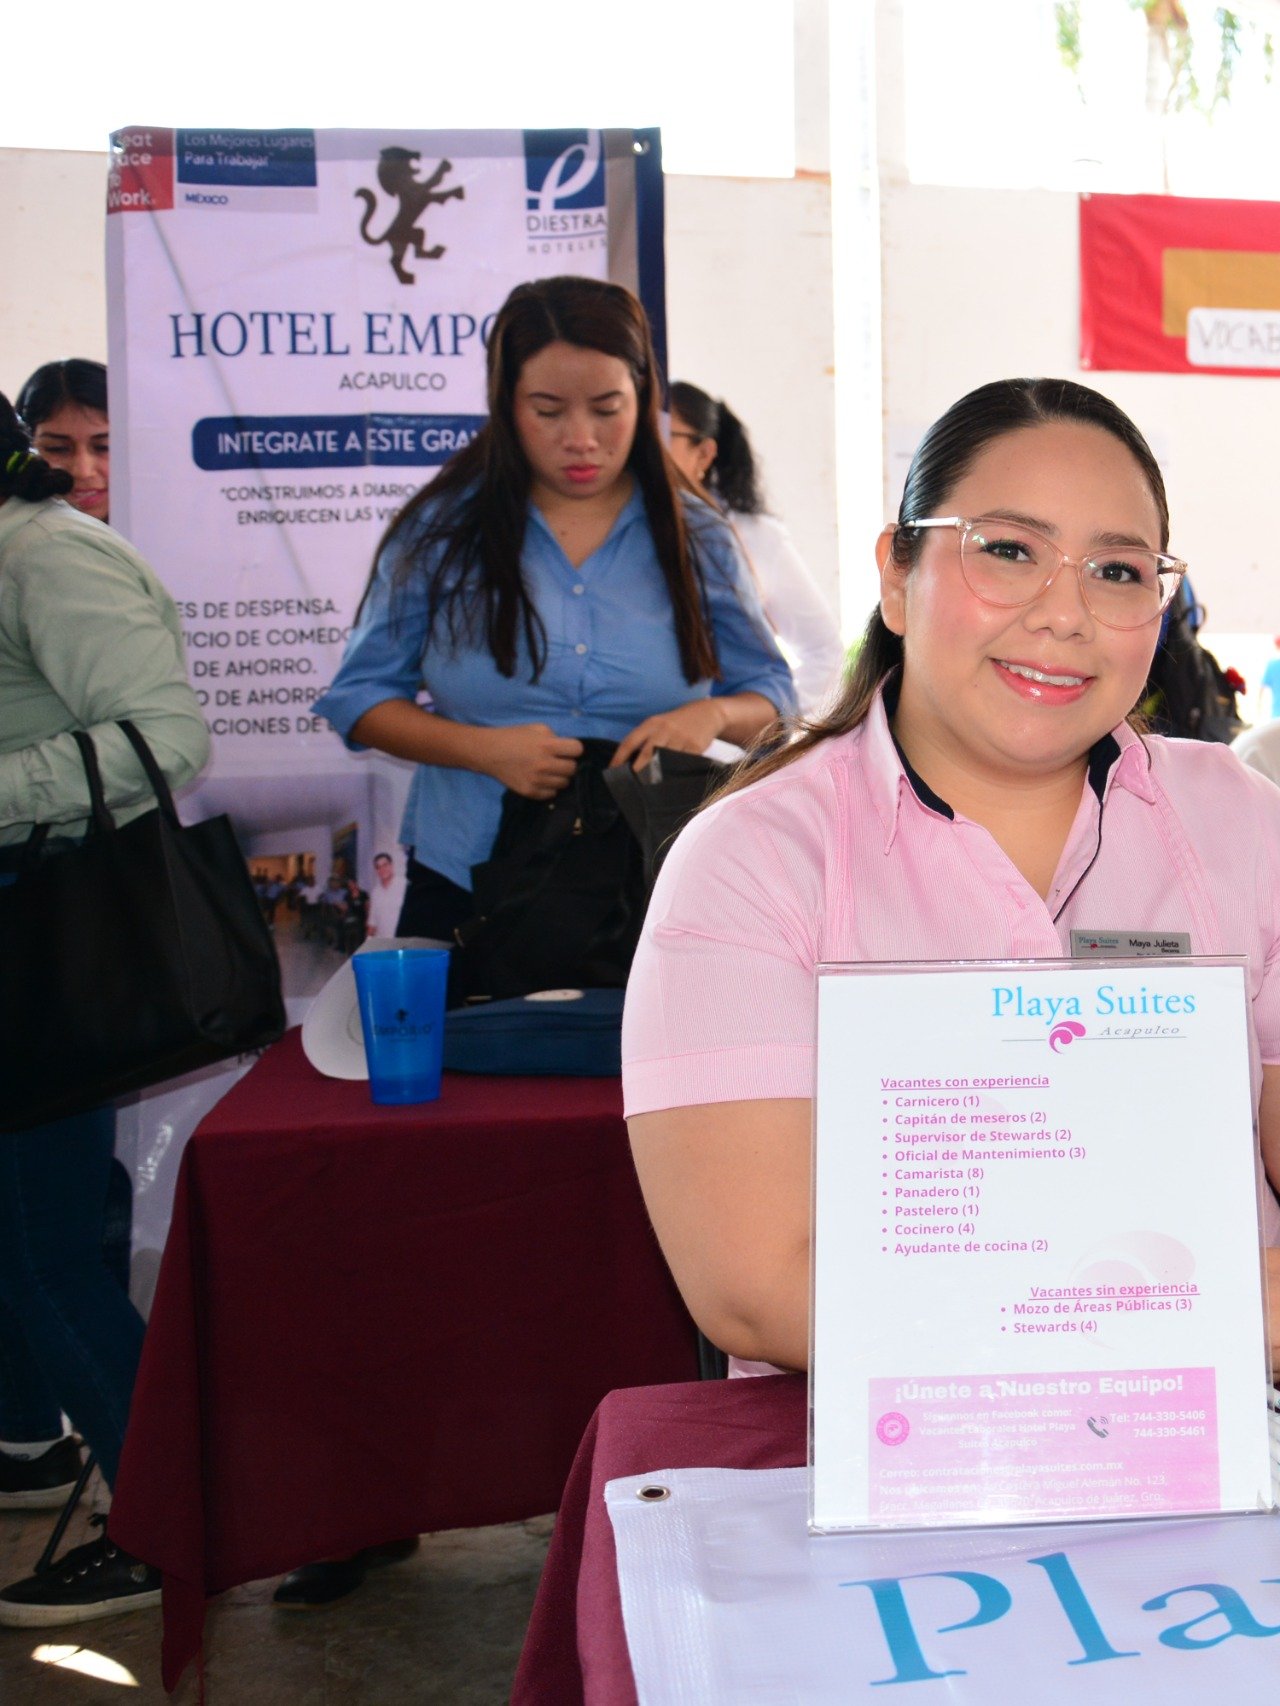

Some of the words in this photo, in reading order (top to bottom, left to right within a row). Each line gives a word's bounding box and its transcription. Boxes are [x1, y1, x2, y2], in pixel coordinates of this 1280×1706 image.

[185, 134, 205, 147] Los
[210, 134, 261, 150] Mejores
[264, 134, 314, 150] Lugares
[185, 152, 214, 166] Para
[526, 213, 607, 233] DIESTRA
[526, 238, 607, 255] HOTELES
[170, 311, 350, 358] HOTEL
[339, 372, 446, 392] ACAPULCO
[218, 430, 338, 456] INTEGRATE
[344, 430, 362, 452] A
[366, 428, 416, 452] ESTE
[350, 484, 359, 498] A
[237, 507, 340, 526] ENRIQUECEN
[345, 507, 372, 523] LAS
[203, 602, 229, 619] DE
[235, 599, 341, 618] DESPENSA.
[236, 630, 261, 647] DE
[193, 660, 220, 678] DE
[225, 658, 318, 677] AHORRO.
[215, 689, 241, 707] DE
[296, 716, 321, 733] DE
[1129, 939, 1151, 949] Maya
[1153, 940, 1179, 948] Julieta
[991, 986, 1082, 1025] Playa
[1095, 985, 1196, 1015] Suites
[1101, 1025, 1180, 1039] Acapulco
[881, 1077, 942, 1089] Vacantes
[945, 1079, 969, 1087] con
[972, 1075, 1049, 1090] experiencia
[895, 1096, 960, 1107] Carnicero
[963, 1095, 980, 1108] (1)
[895, 1112, 947, 1127] Capitán
[950, 1113, 967, 1124] de
[970, 1114, 1027, 1124] meseros
[1030, 1111, 1047, 1124] (2)
[895, 1131, 966, 1146] Supervisor
[970, 1131, 986, 1142] de
[990, 1129, 1052, 1142] Stewards
[1055, 1128, 1072, 1142] (2)
[895, 1149, 937, 1161] Oficial
[940, 1149, 958, 1160] de
[962, 1147, 1066, 1160] Mantenimiento
[1069, 1147, 1086, 1160] (3)
[895, 1167, 964, 1180] Camarista
[967, 1167, 984, 1180] (8)
[895, 1186, 960, 1198] Panadero
[963, 1185, 980, 1199] (1)
[895, 1204, 959, 1217] Pastelero
[962, 1204, 979, 1217] (1)
[895, 1223, 955, 1235] Cocinero
[958, 1222, 975, 1236] (4)
[895, 1241, 961, 1256] Ayudante
[964, 1241, 981, 1253] de
[984, 1240, 1028, 1252] cocina
[1031, 1239, 1048, 1253] (2)
[1031, 1286, 1092, 1298] Vacantes
[1096, 1284, 1117, 1296] sin
[1120, 1282, 1198, 1297] experiencia
[1014, 1303, 1050, 1315] Mozo
[1053, 1302, 1070, 1314] de
[1074, 1299, 1112, 1313] Áreas
[1116, 1298, 1172, 1312] Públicas
[1175, 1298, 1192, 1312] (3)
[1014, 1320, 1077, 1333] Stewards
[1080, 1319, 1098, 1333] (4)
[895, 1379, 972, 1403] ¡Únete
[979, 1384, 994, 1399] a
[1000, 1378, 1092, 1398] Nuestro
[1099, 1375, 1184, 1396] Equipo!
[977, 1411, 989, 1420] en
[992, 1409, 1038, 1419] Facebook
[1109, 1412, 1130, 1424] Tel:
[1133, 1410, 1206, 1423] 744-330-5406
[920, 1426, 966, 1436] Vacantes
[968, 1424, 1017, 1434] Laborales
[1019, 1423, 1048, 1433] Hotel
[1050, 1422, 1076, 1434] Playa
[1133, 1427, 1206, 1439] 744-330-5461
[958, 1439, 989, 1449] Suites
[992, 1438, 1037, 1450] Acapulco
[880, 1468, 920, 1479] Correo:
[880, 1486, 901, 1496] Nos
[1044, 1478, 1079, 1492] Miguel
[1087, 1495, 1099, 1505] de
